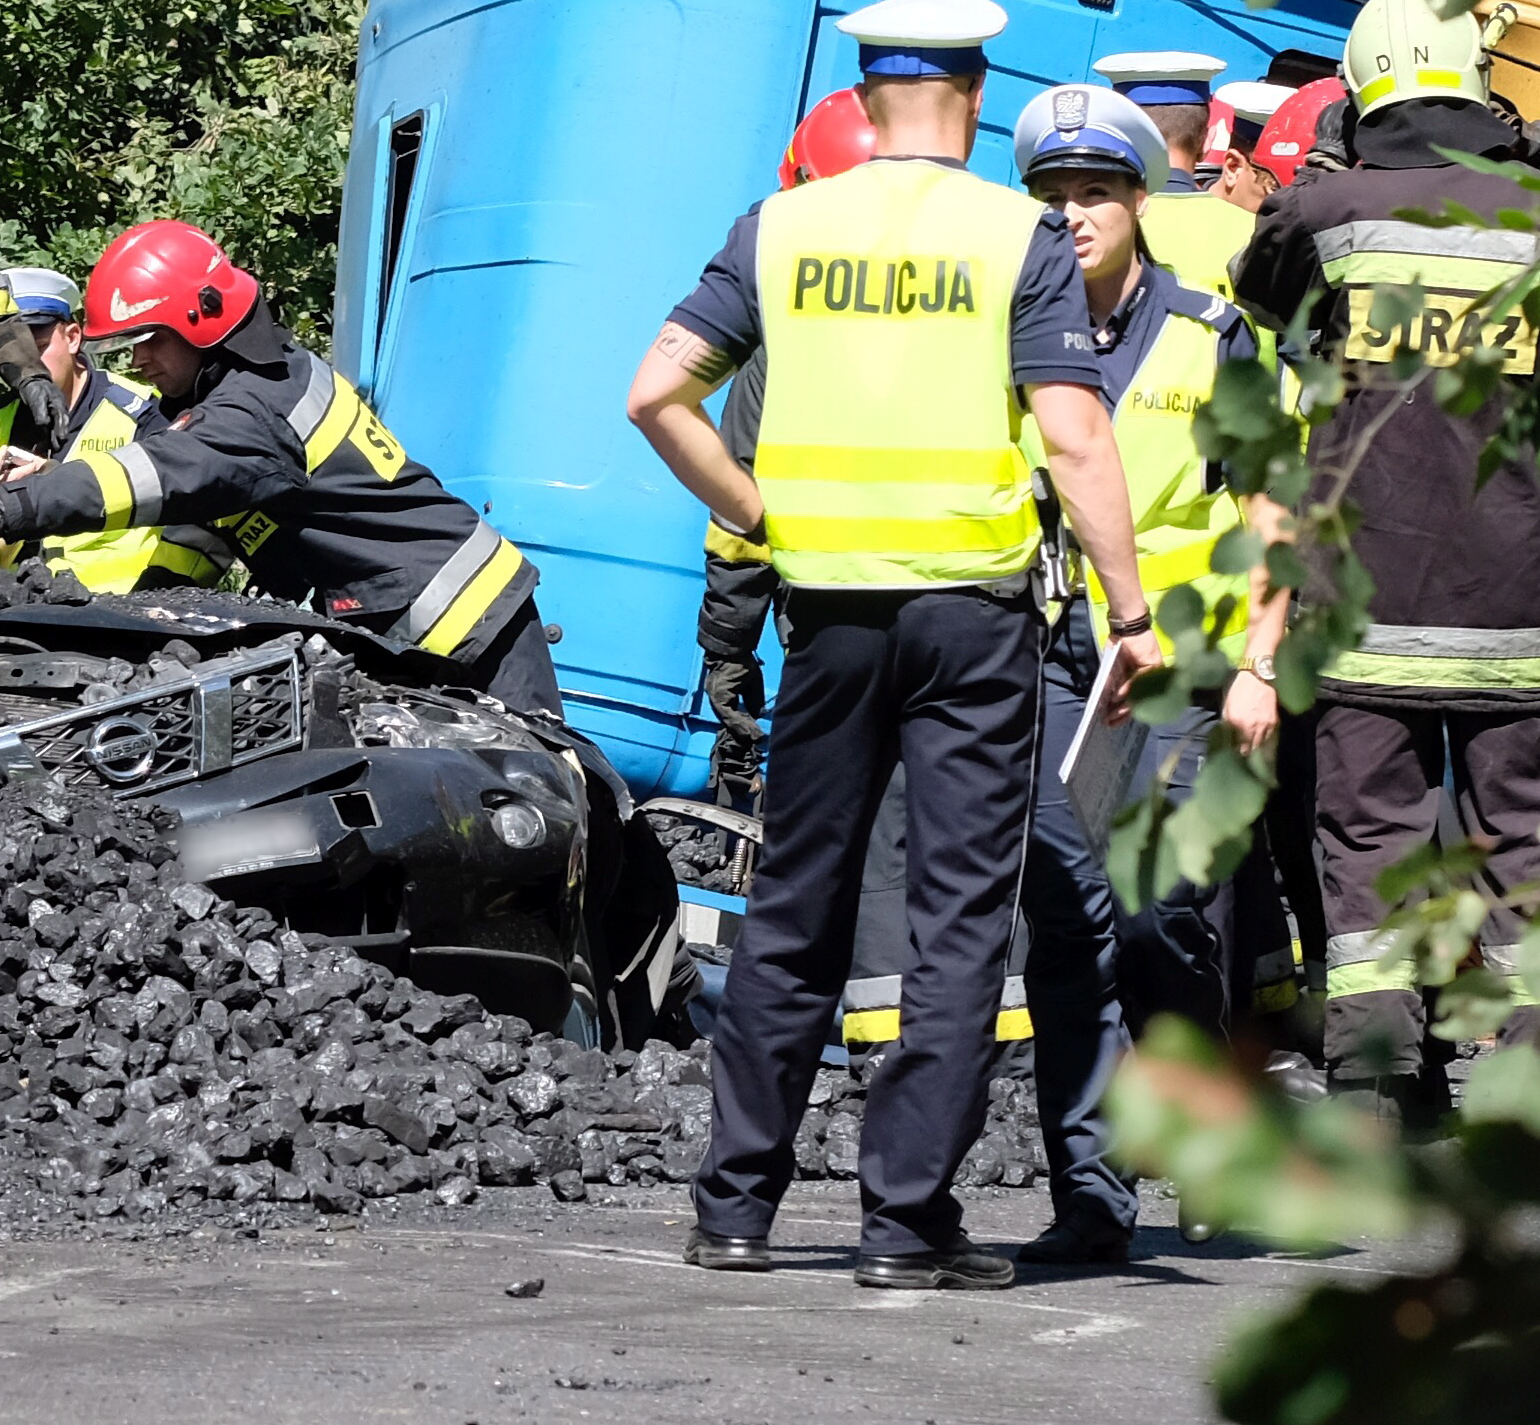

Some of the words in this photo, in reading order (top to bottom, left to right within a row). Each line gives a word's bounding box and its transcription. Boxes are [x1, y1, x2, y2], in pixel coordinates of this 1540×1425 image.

[1376, 54, 1391, 73] D
[1414, 46, 1429, 64] N
[794, 258, 975, 315] POLICJA
[80, 437, 125, 452] POLICJA
[99, 738, 152, 760] NISSAN
